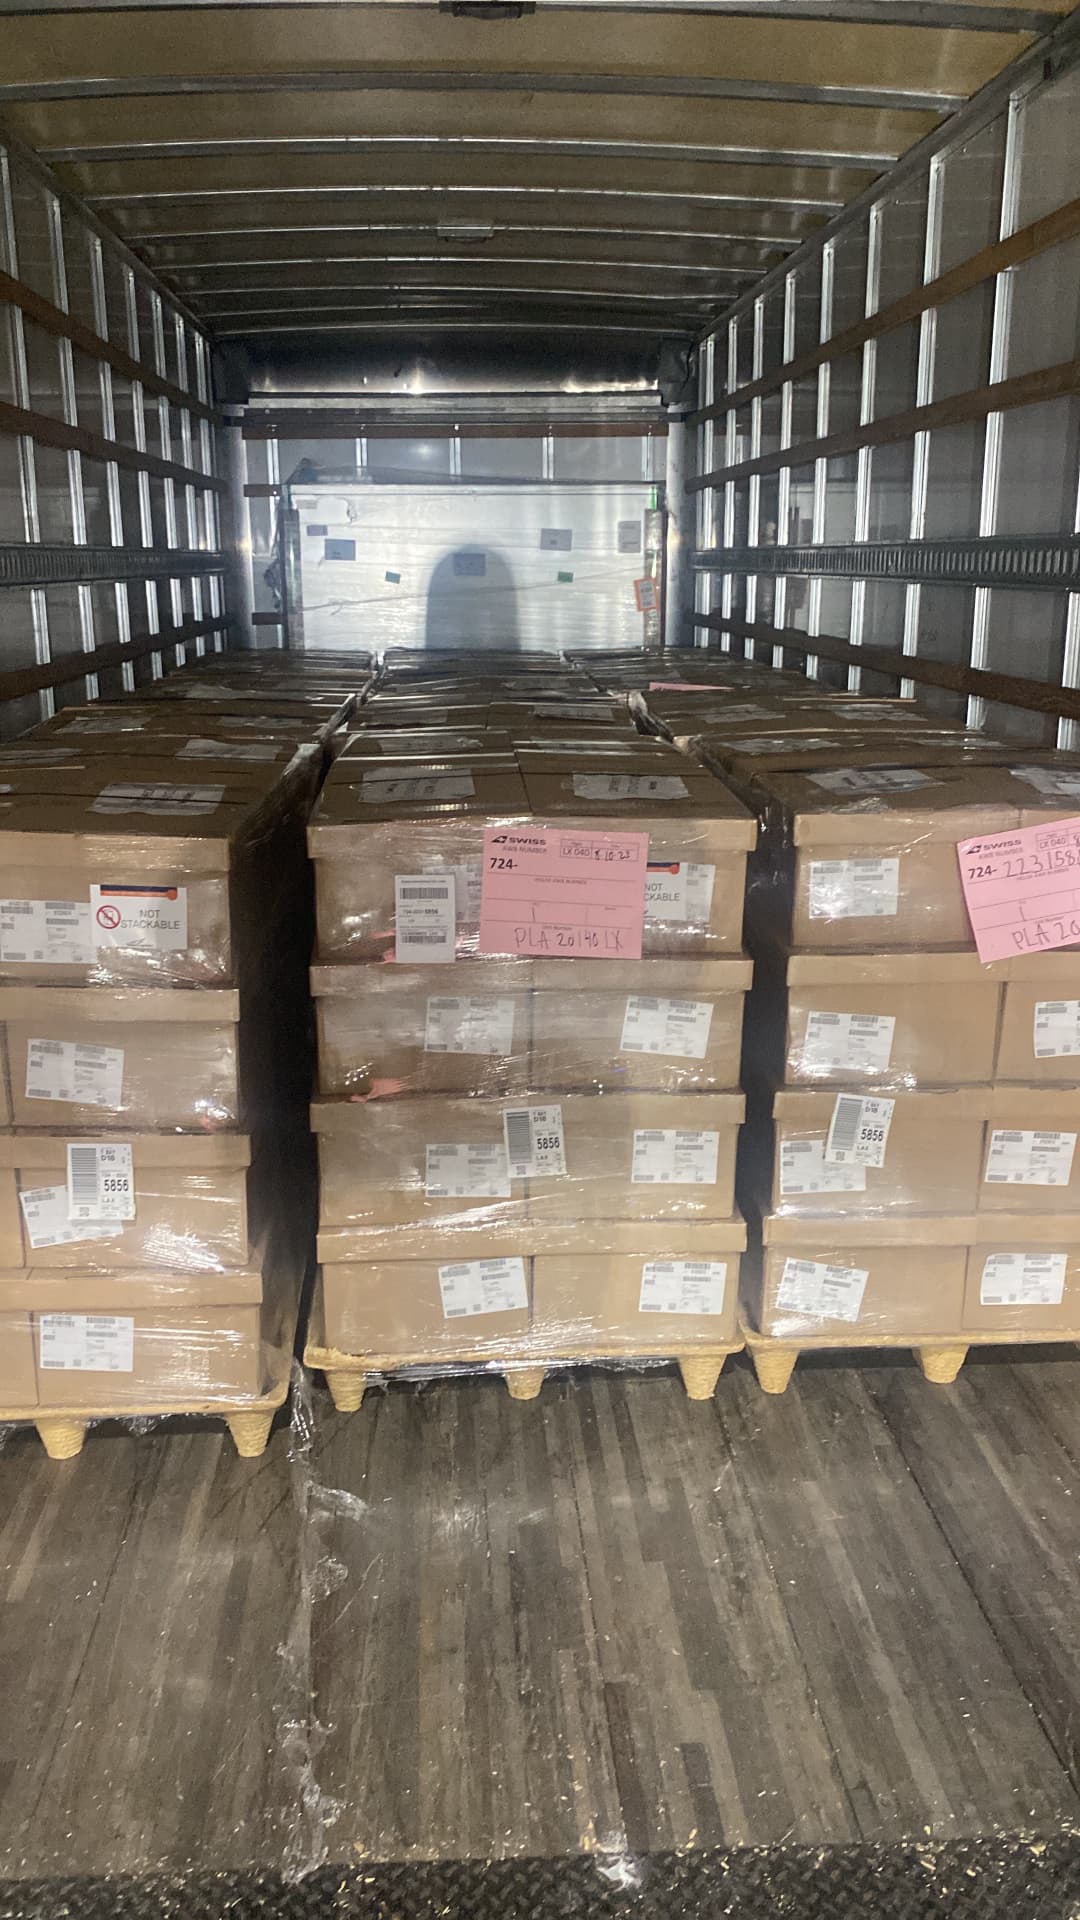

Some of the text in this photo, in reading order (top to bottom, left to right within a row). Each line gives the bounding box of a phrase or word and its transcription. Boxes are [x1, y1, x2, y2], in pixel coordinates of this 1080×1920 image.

[508, 837, 547, 845] SWISS
[983, 840, 1022, 851] SWISS
[519, 846, 547, 854] NUMBER
[489, 857, 519, 870] 724-
[968, 865, 998, 880] 724-
[645, 882, 664, 892] NOT
[644, 892, 681, 902] CKABLE
[139, 909, 161, 918] NOT
[120, 919, 181, 930] STACKABLE
[514, 927, 552, 950] PLA
[1011, 922, 1050, 950] PLA
[861, 1128, 884, 1142] 5856
[536, 1136, 561, 1150] 5856
[104, 1178, 129, 1192] 5856
